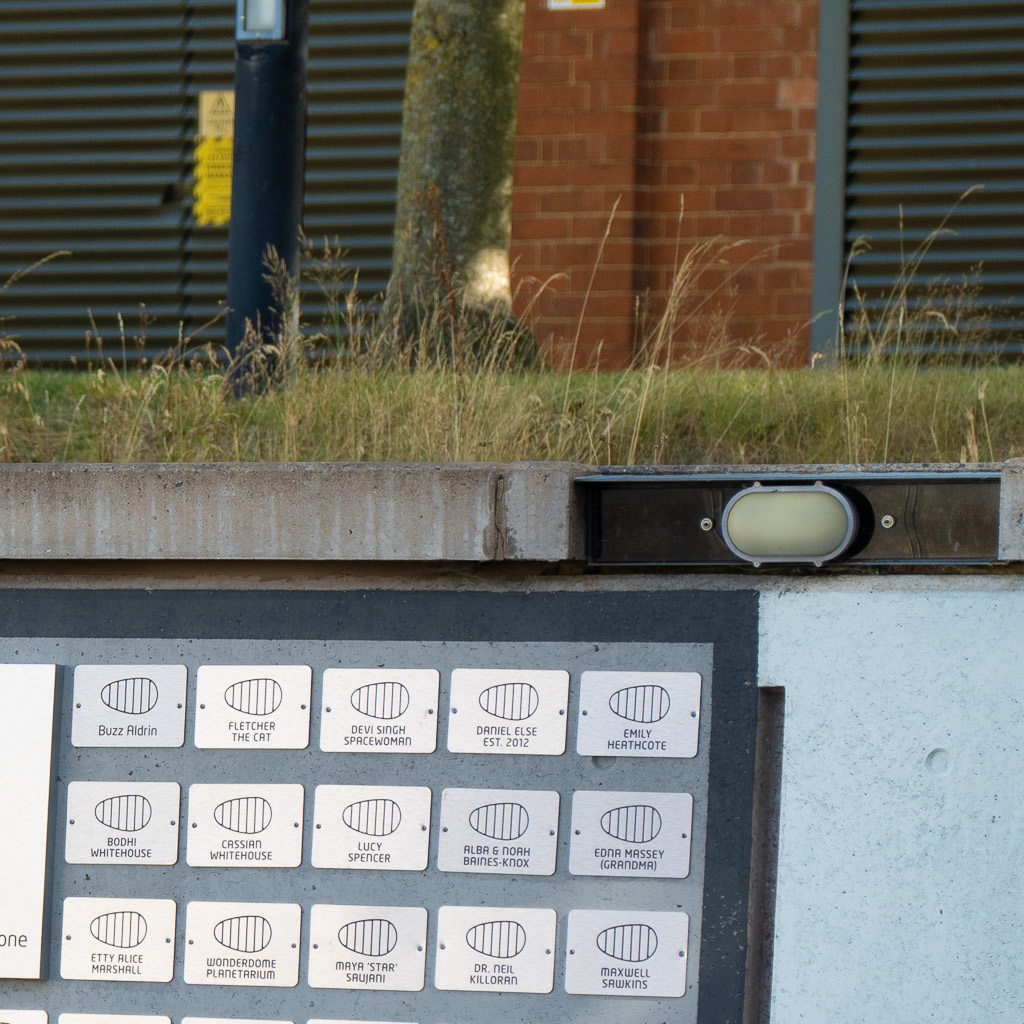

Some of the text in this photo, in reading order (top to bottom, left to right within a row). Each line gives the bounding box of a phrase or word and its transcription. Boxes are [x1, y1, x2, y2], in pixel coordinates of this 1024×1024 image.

[98, 724, 158, 737] Buzz Aldrin
[228, 721, 276, 731] FLETCHER
[351, 724, 406, 735] DEVI SINGH
[476, 725, 538, 737] DANIEL ELSE
[231, 732, 272, 742] THE CAT
[623, 728, 653, 739] EMILY
[343, 736, 412, 746] SPACEWOMAN
[483, 737, 530, 748] EST. 2012
[607, 739, 667, 751] HEATHCOTE
[107, 837, 137, 847] BODHI
[221, 839, 262, 850] CASSIAN
[357, 841, 383, 852] LUCY
[90, 848, 152, 859] WHITEHOUSE
[209, 850, 273, 861] WHITEHOUSE
[463, 844, 531, 857] ALBA & NOAH
[594, 847, 665, 860] EDNA MASSEY
[347, 852, 391, 864] SPENCER
[463, 856, 530, 868] BAINES-KNOX
[600, 858, 658, 872] (GRANDMA)
[90, 952, 144, 964] ETTY ALICE
[206, 957, 277, 969] WONDERDOME
[91, 964, 142, 975] MARSHALL
[335, 961, 365, 972] MAYA
[474, 963, 515, 975] DR. NEIL
[206, 968, 276, 980] PLANETARIUM
[345, 972, 386, 985] SAUJANI
[600, 967, 651, 979] MAXWELL
[469, 974, 518, 986] KILLORAN
[601, 978, 648, 990] SAWKINS
